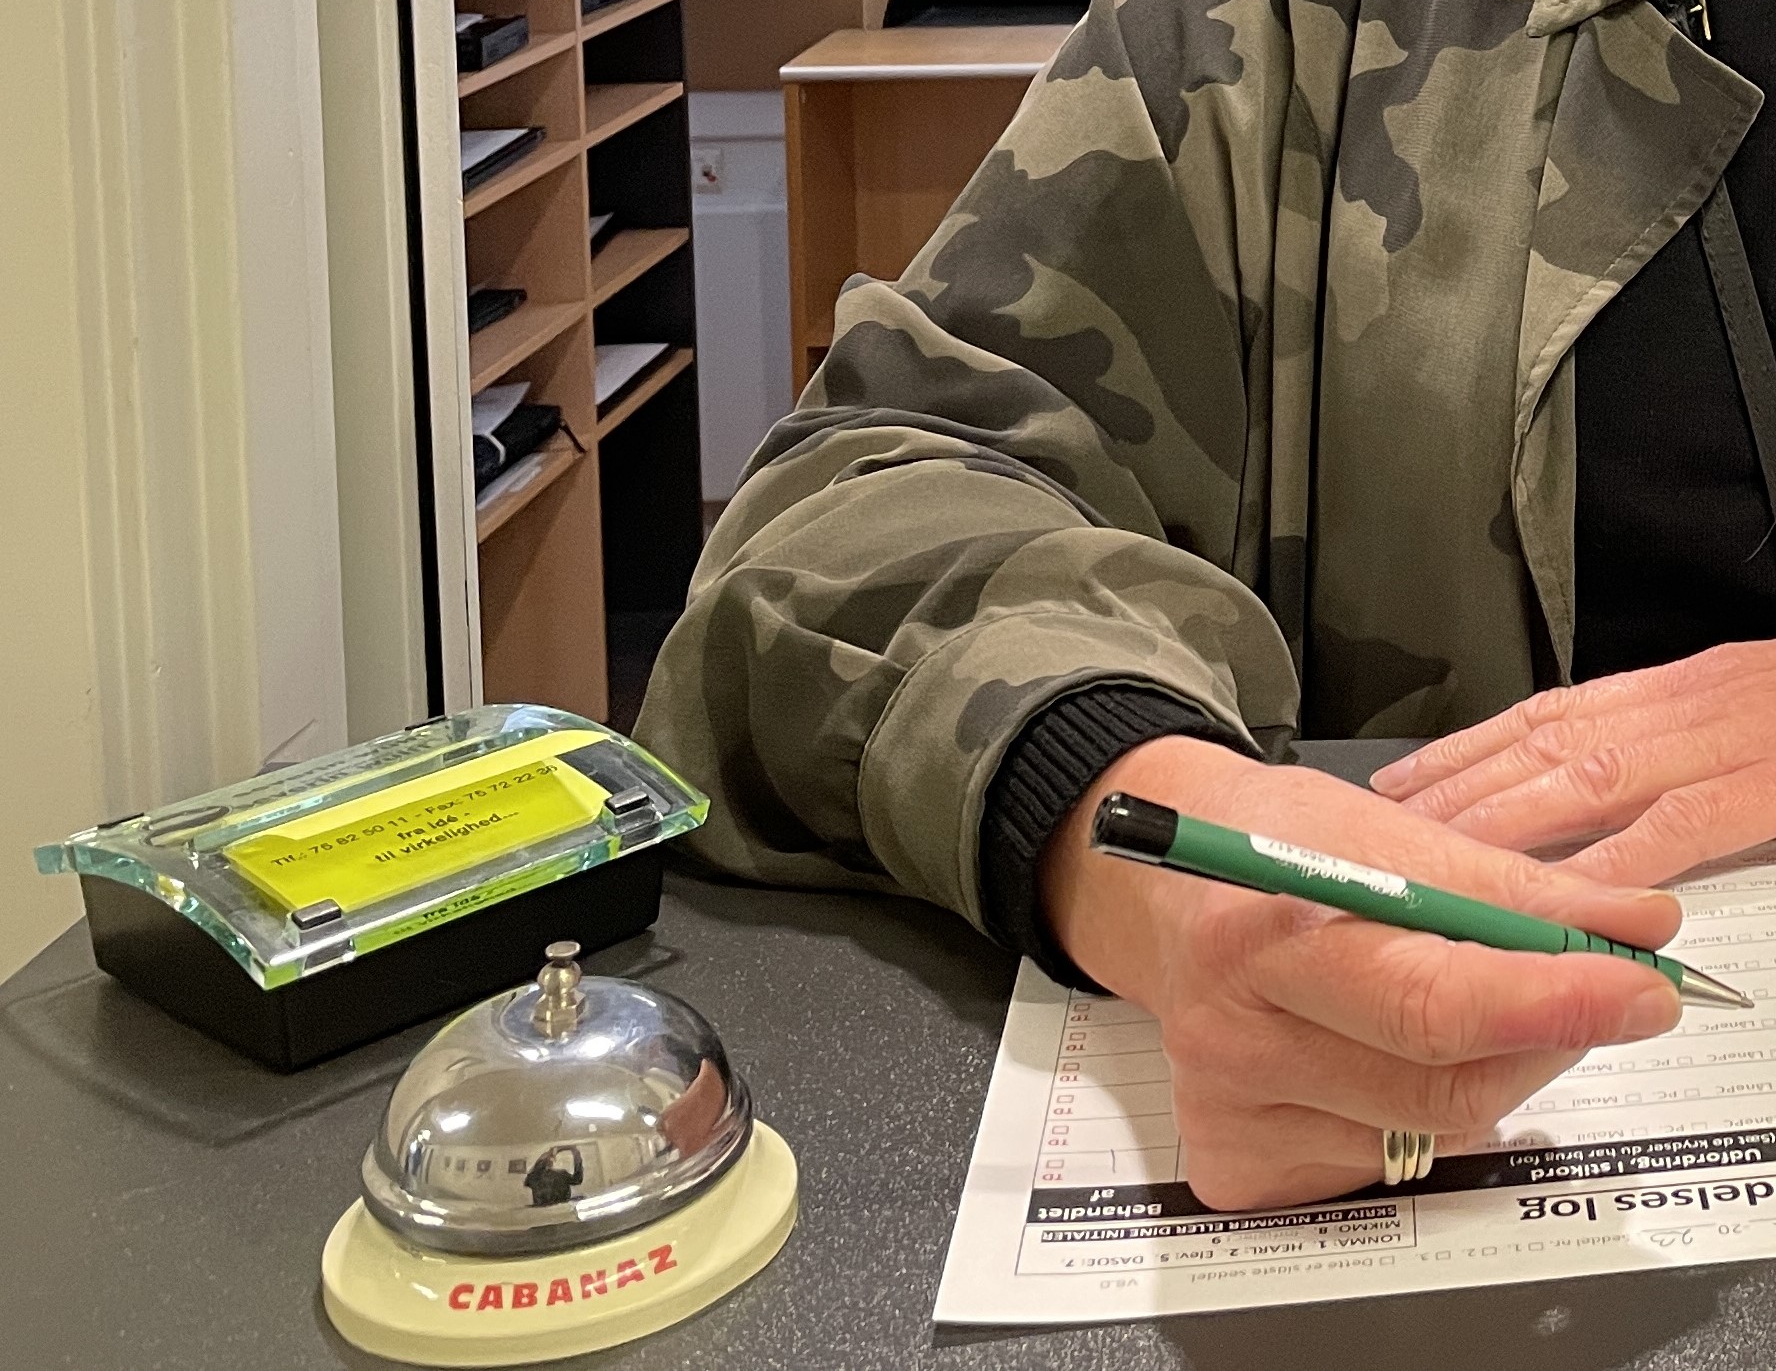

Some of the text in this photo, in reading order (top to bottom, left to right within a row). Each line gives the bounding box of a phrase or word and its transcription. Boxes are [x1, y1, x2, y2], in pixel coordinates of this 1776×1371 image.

[388, 817, 408, 827] 11
[487, 781, 512, 792] 72
[513, 772, 535, 784] 22
[397, 828, 426, 841] fra
[374, 850, 397, 862] til
[1053, 1107, 1073, 1115] TD
[1048, 1138, 1068, 1146] TD
[1645, 1137, 1709, 1154] krydser
[1712, 1136, 1734, 1148] de
[1545, 1149, 1584, 1164] brug
[1589, 1147, 1616, 1161] har
[1620, 1145, 1643, 1159] du
[1629, 1147, 1762, 1169] Udfordring,
[1509, 1154, 1539, 1167] for)
[1042, 1173, 1063, 1181] TD
[1530, 1161, 1611, 1181] stikord
[1089, 1188, 1115, 1202] af
[1037, 1203, 1163, 1221] Behandlet
[1516, 1196, 1596, 1221] log
[1041, 1205, 1396, 1242] SKRIV DIT NUMMER ELLER DINE INITIALER
[1251, 1265, 1300, 1277] sidste
[1306, 1262, 1323, 1271] er
[1328, 1258, 1373, 1270] Dette
[449, 1243, 678, 1312] CABANAZ
